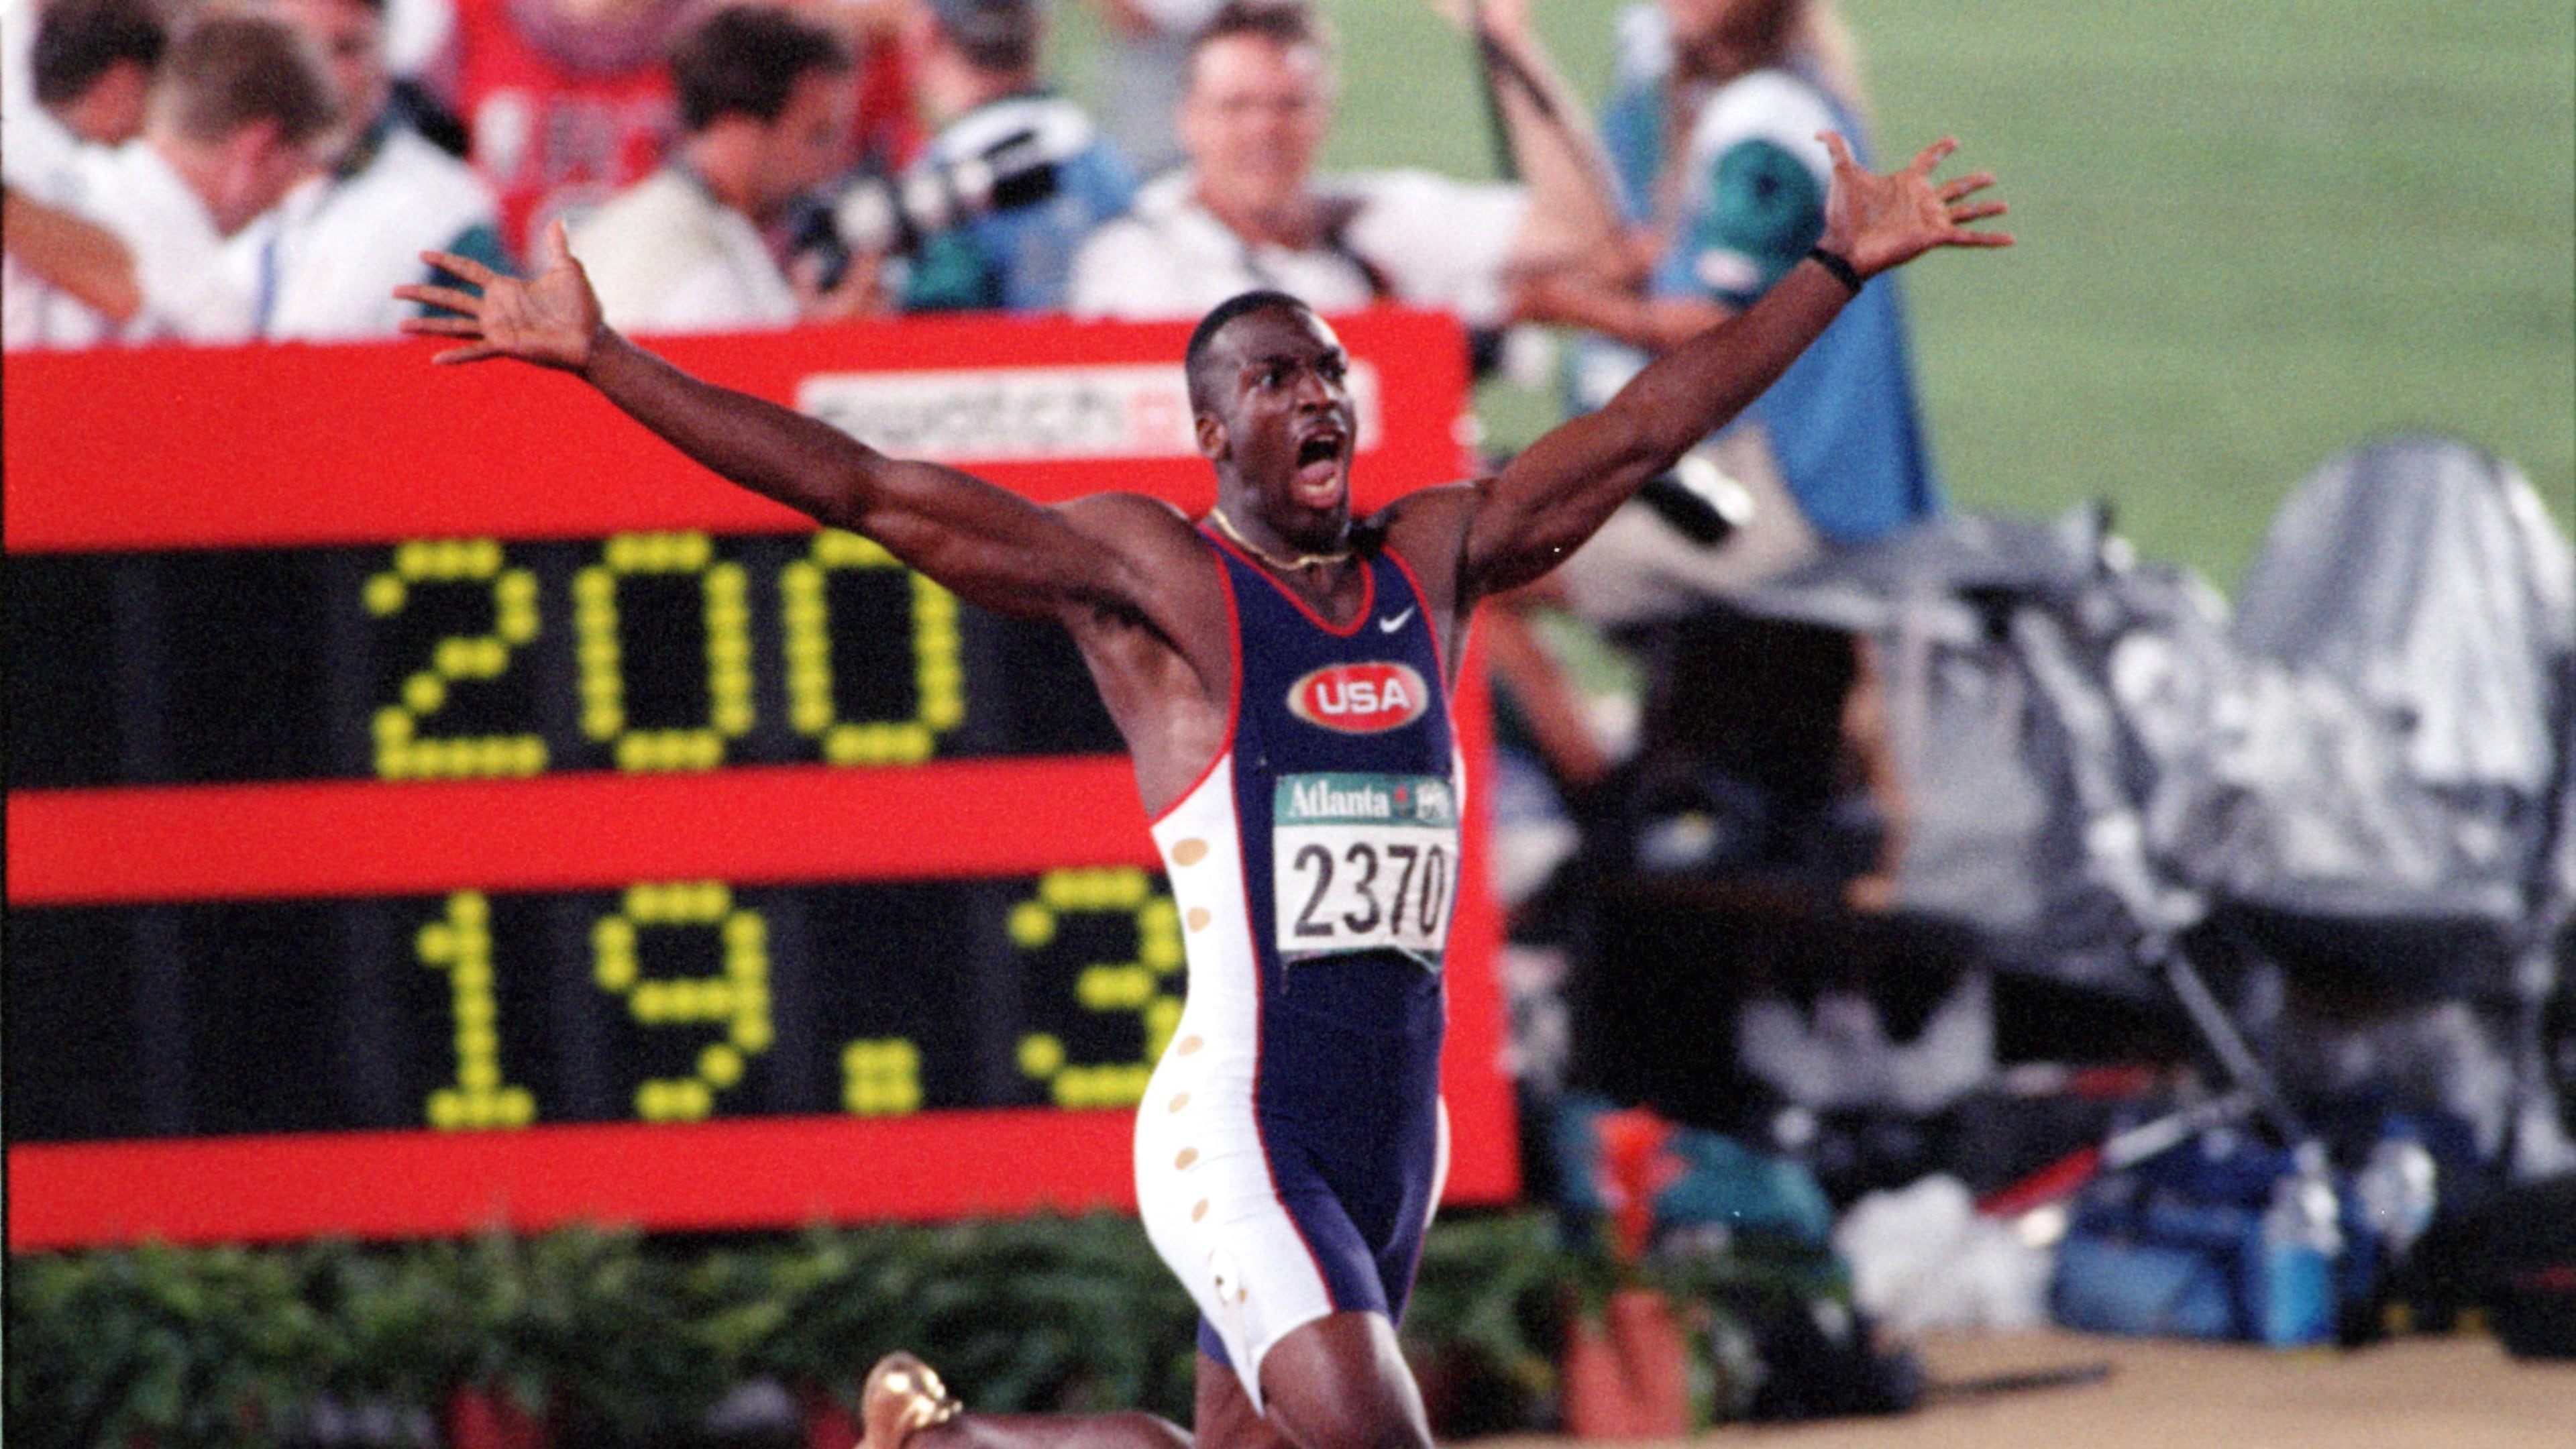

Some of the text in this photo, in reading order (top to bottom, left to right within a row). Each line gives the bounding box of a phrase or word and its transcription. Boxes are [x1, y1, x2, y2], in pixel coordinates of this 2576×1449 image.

[366, 530, 965, 778] 200
[1316, 680, 1410, 714] USA
[1289, 780, 1389, 817] Atlanta
[1293, 843, 1445, 937] 2370
